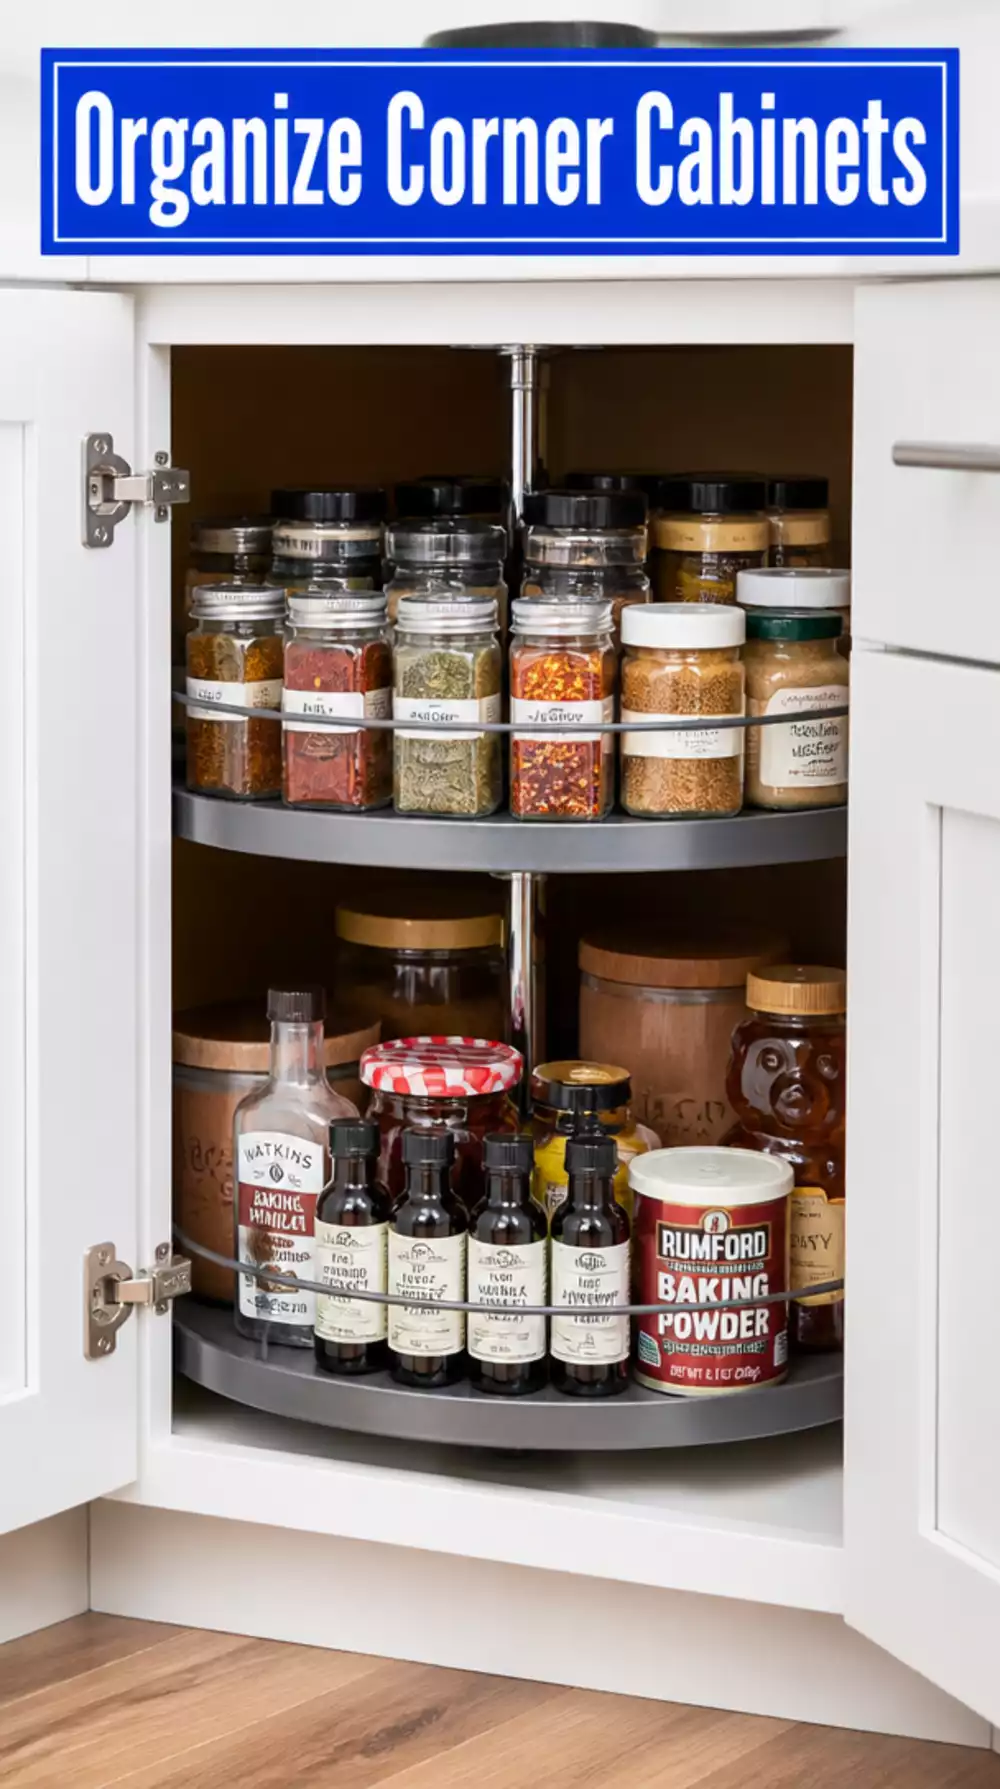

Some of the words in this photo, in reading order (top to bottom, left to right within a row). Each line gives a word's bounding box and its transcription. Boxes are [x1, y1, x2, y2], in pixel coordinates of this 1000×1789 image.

[244, 1143, 312, 1169] WATKINS
[661, 1229, 767, 1261] RUMFORD
[657, 1271, 770, 1303] BAKING
[657, 1308, 770, 1341] POWDER
